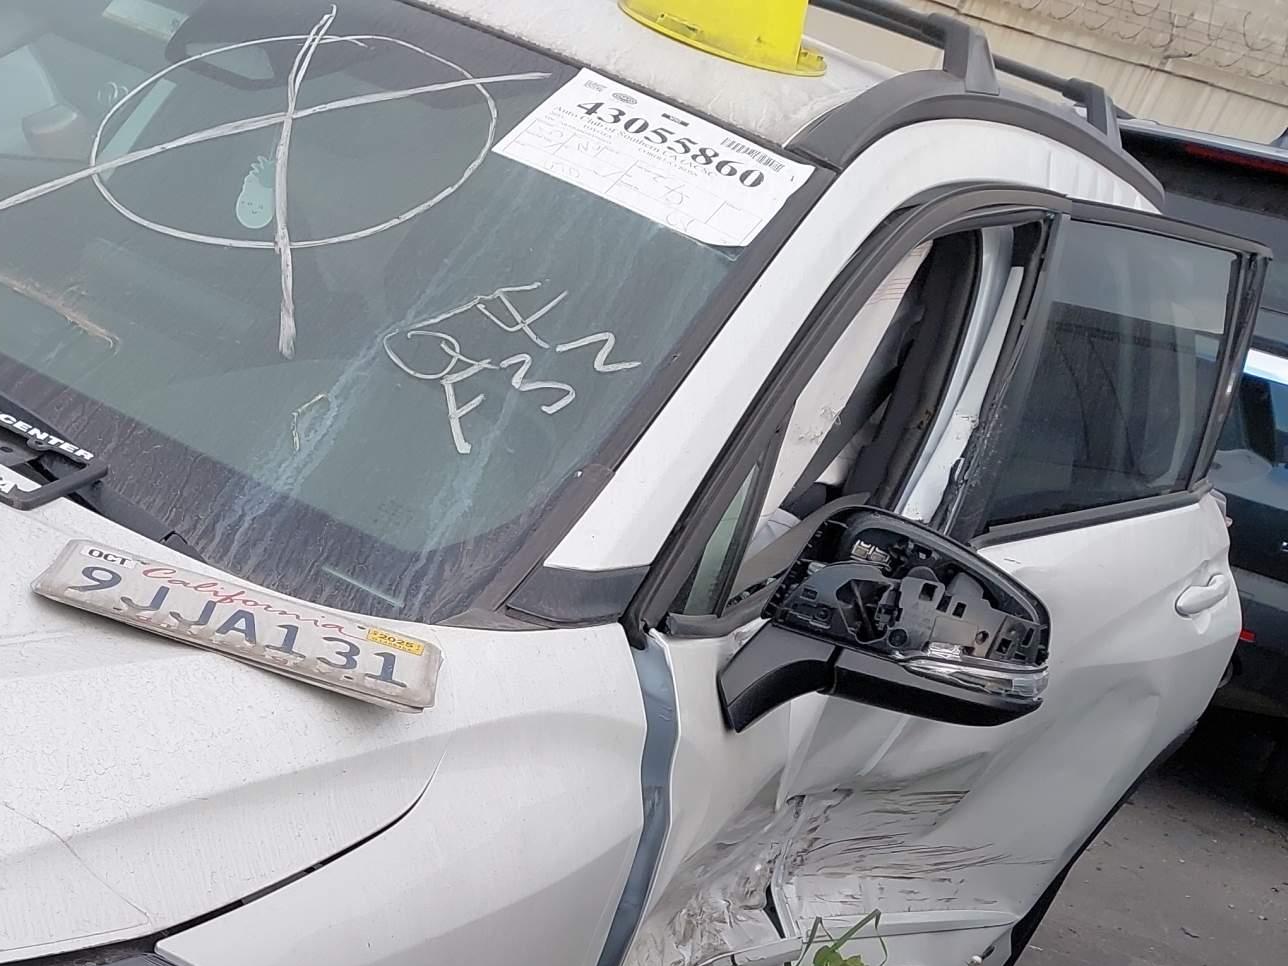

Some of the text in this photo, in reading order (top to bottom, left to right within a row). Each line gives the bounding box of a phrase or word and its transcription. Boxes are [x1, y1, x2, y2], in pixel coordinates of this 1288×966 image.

[553, 104, 578, 120] Auto
[579, 113, 603, 128] Club
[603, 124, 617, 136] of
[616, 129, 660, 153] Southern
[577, 101, 765, 188] 43055860
[88, 548, 132, 565] OCT
[65, 566, 407, 688] 9JJA131
[142, 567, 366, 640] California
